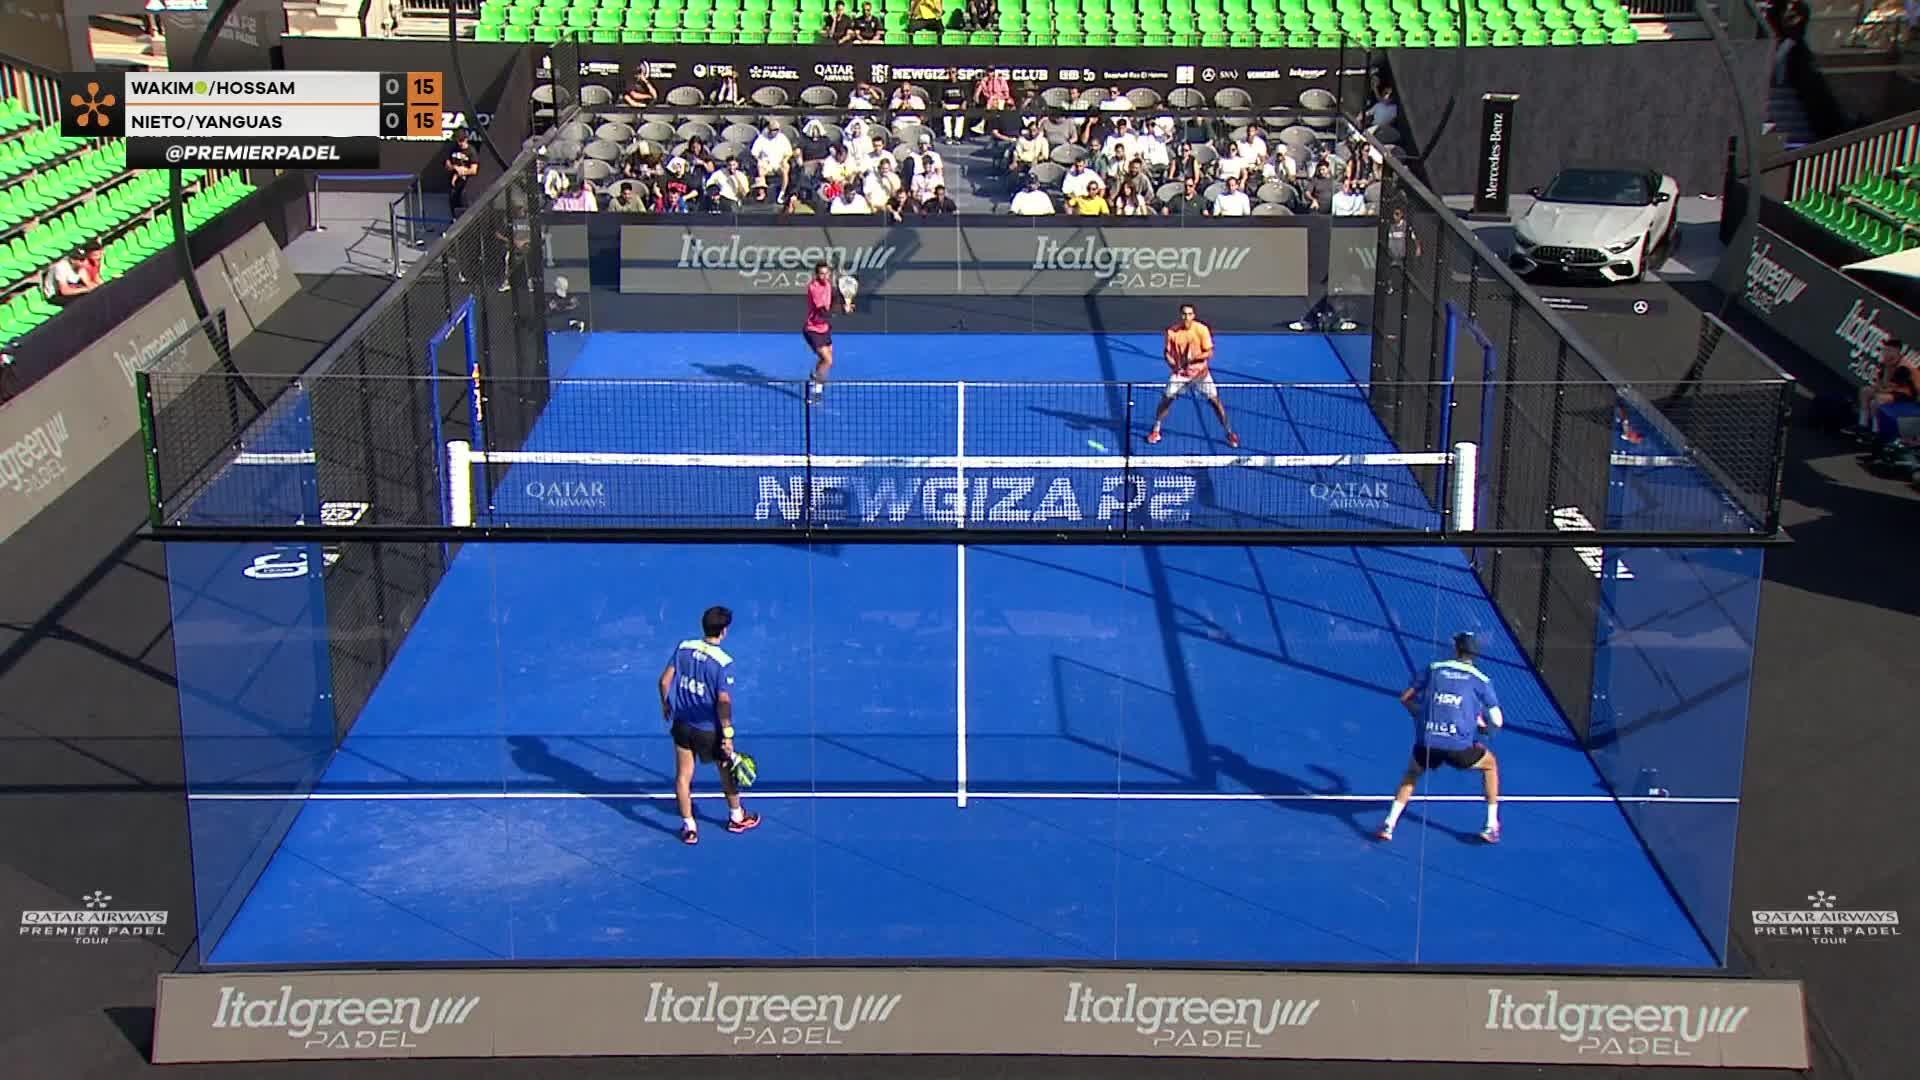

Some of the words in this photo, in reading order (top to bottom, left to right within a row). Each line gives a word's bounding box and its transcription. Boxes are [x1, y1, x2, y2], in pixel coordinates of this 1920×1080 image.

[814, 64, 854, 76] QATAR
[892, 68, 954, 80] NEWGIZ
[1012, 69, 1048, 80] CLUB
[1485, 112, 1504, 200] Mercedes-Benz
[678, 234, 863, 277] Italgreen
[1033, 235, 1217, 277] Italgreen
[1109, 273, 1201, 288] PADEL
[526, 481, 604, 500] QATAR
[754, 476, 1083, 522] NEWGIZA
[1097, 475, 1196, 520] P2
[1310, 482, 1390, 501] QATAR
[547, 498, 606, 507] AIRWAYS
[1329, 498, 1390, 509] AIRWAYS
[25, 912, 84, 923] QATAR
[88, 912, 165, 922] AIRWAYS
[1755, 912, 1815, 924] QATAR
[1820, 912, 1896, 922] AIRWAYS
[20, 926, 99, 936] PREMIER
[108, 926, 165, 936] PADEL
[1754, 926, 1834, 935] PREMIER
[1843, 926, 1901, 935] PADEL
[74, 936, 109, 945] TOUR
[1812, 937, 1847, 945] TOUR
[212, 985, 437, 1038] Italgreen
[644, 981, 861, 1033] Italgreen
[1064, 981, 1282, 1035] Italgreen
[1485, 989, 1709, 1042] Italgreen
[304, 1030, 417, 1049] PADEL
[733, 1027, 843, 1045] PADEL
[1153, 1029, 1262, 1048] PADEL
[1578, 1037, 1691, 1056] PADEL
